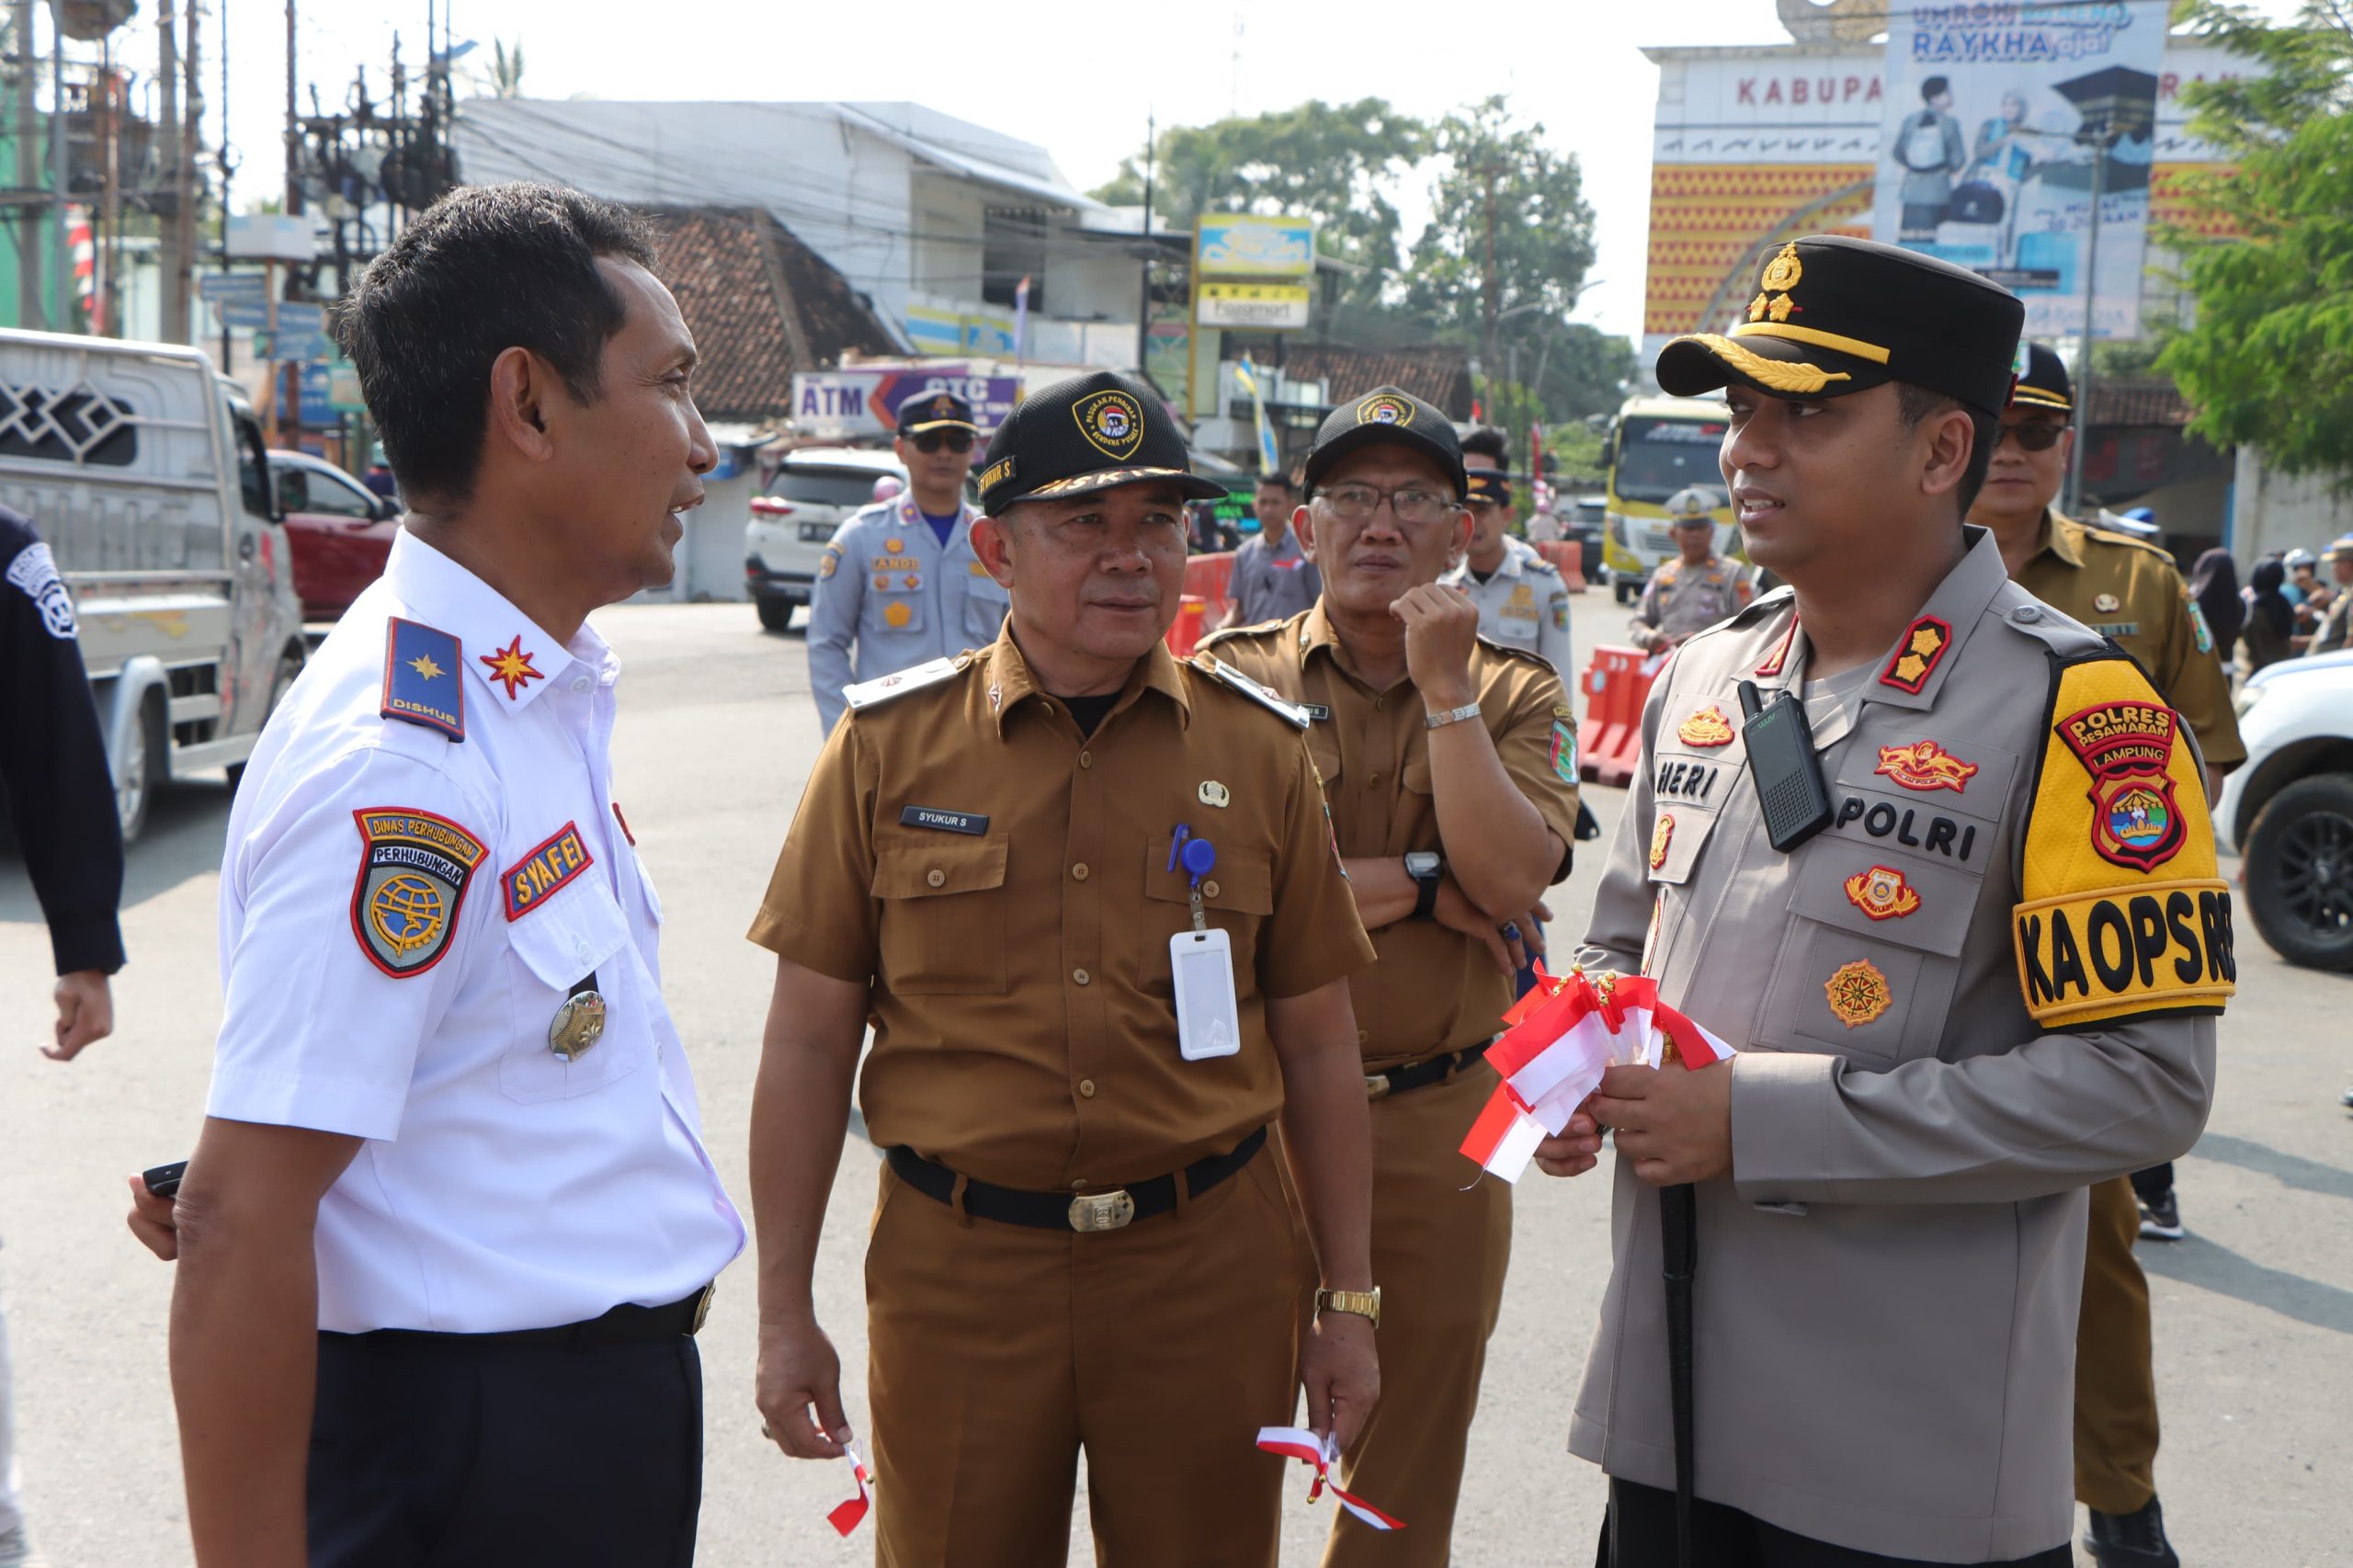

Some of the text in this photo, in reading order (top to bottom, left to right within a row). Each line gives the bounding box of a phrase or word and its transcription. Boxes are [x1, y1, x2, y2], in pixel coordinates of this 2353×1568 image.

[1913, 32, 2055, 61] RAYKHA
[1737, 75, 1883, 105] KABUPA
[801, 386, 863, 415] ATM
[1086, 396, 1108, 423] PASUKAN
[1005, 460, 1010, 477] S
[392, 698, 456, 726] DISHUB
[2070, 706, 2169, 737] POLRES
[2079, 722, 2168, 748] PESAWARAN
[2093, 746, 2164, 768] LAMPUNG
[1656, 761, 1719, 798] HERI
[918, 811, 967, 827] SYUKUR S
[1836, 796, 1976, 861] POLRI
[372, 817, 475, 860] DINAS PERHUBUNGAN
[375, 846, 462, 884] PERHUBUNGAN
[515, 833, 585, 906] SYAFEI
